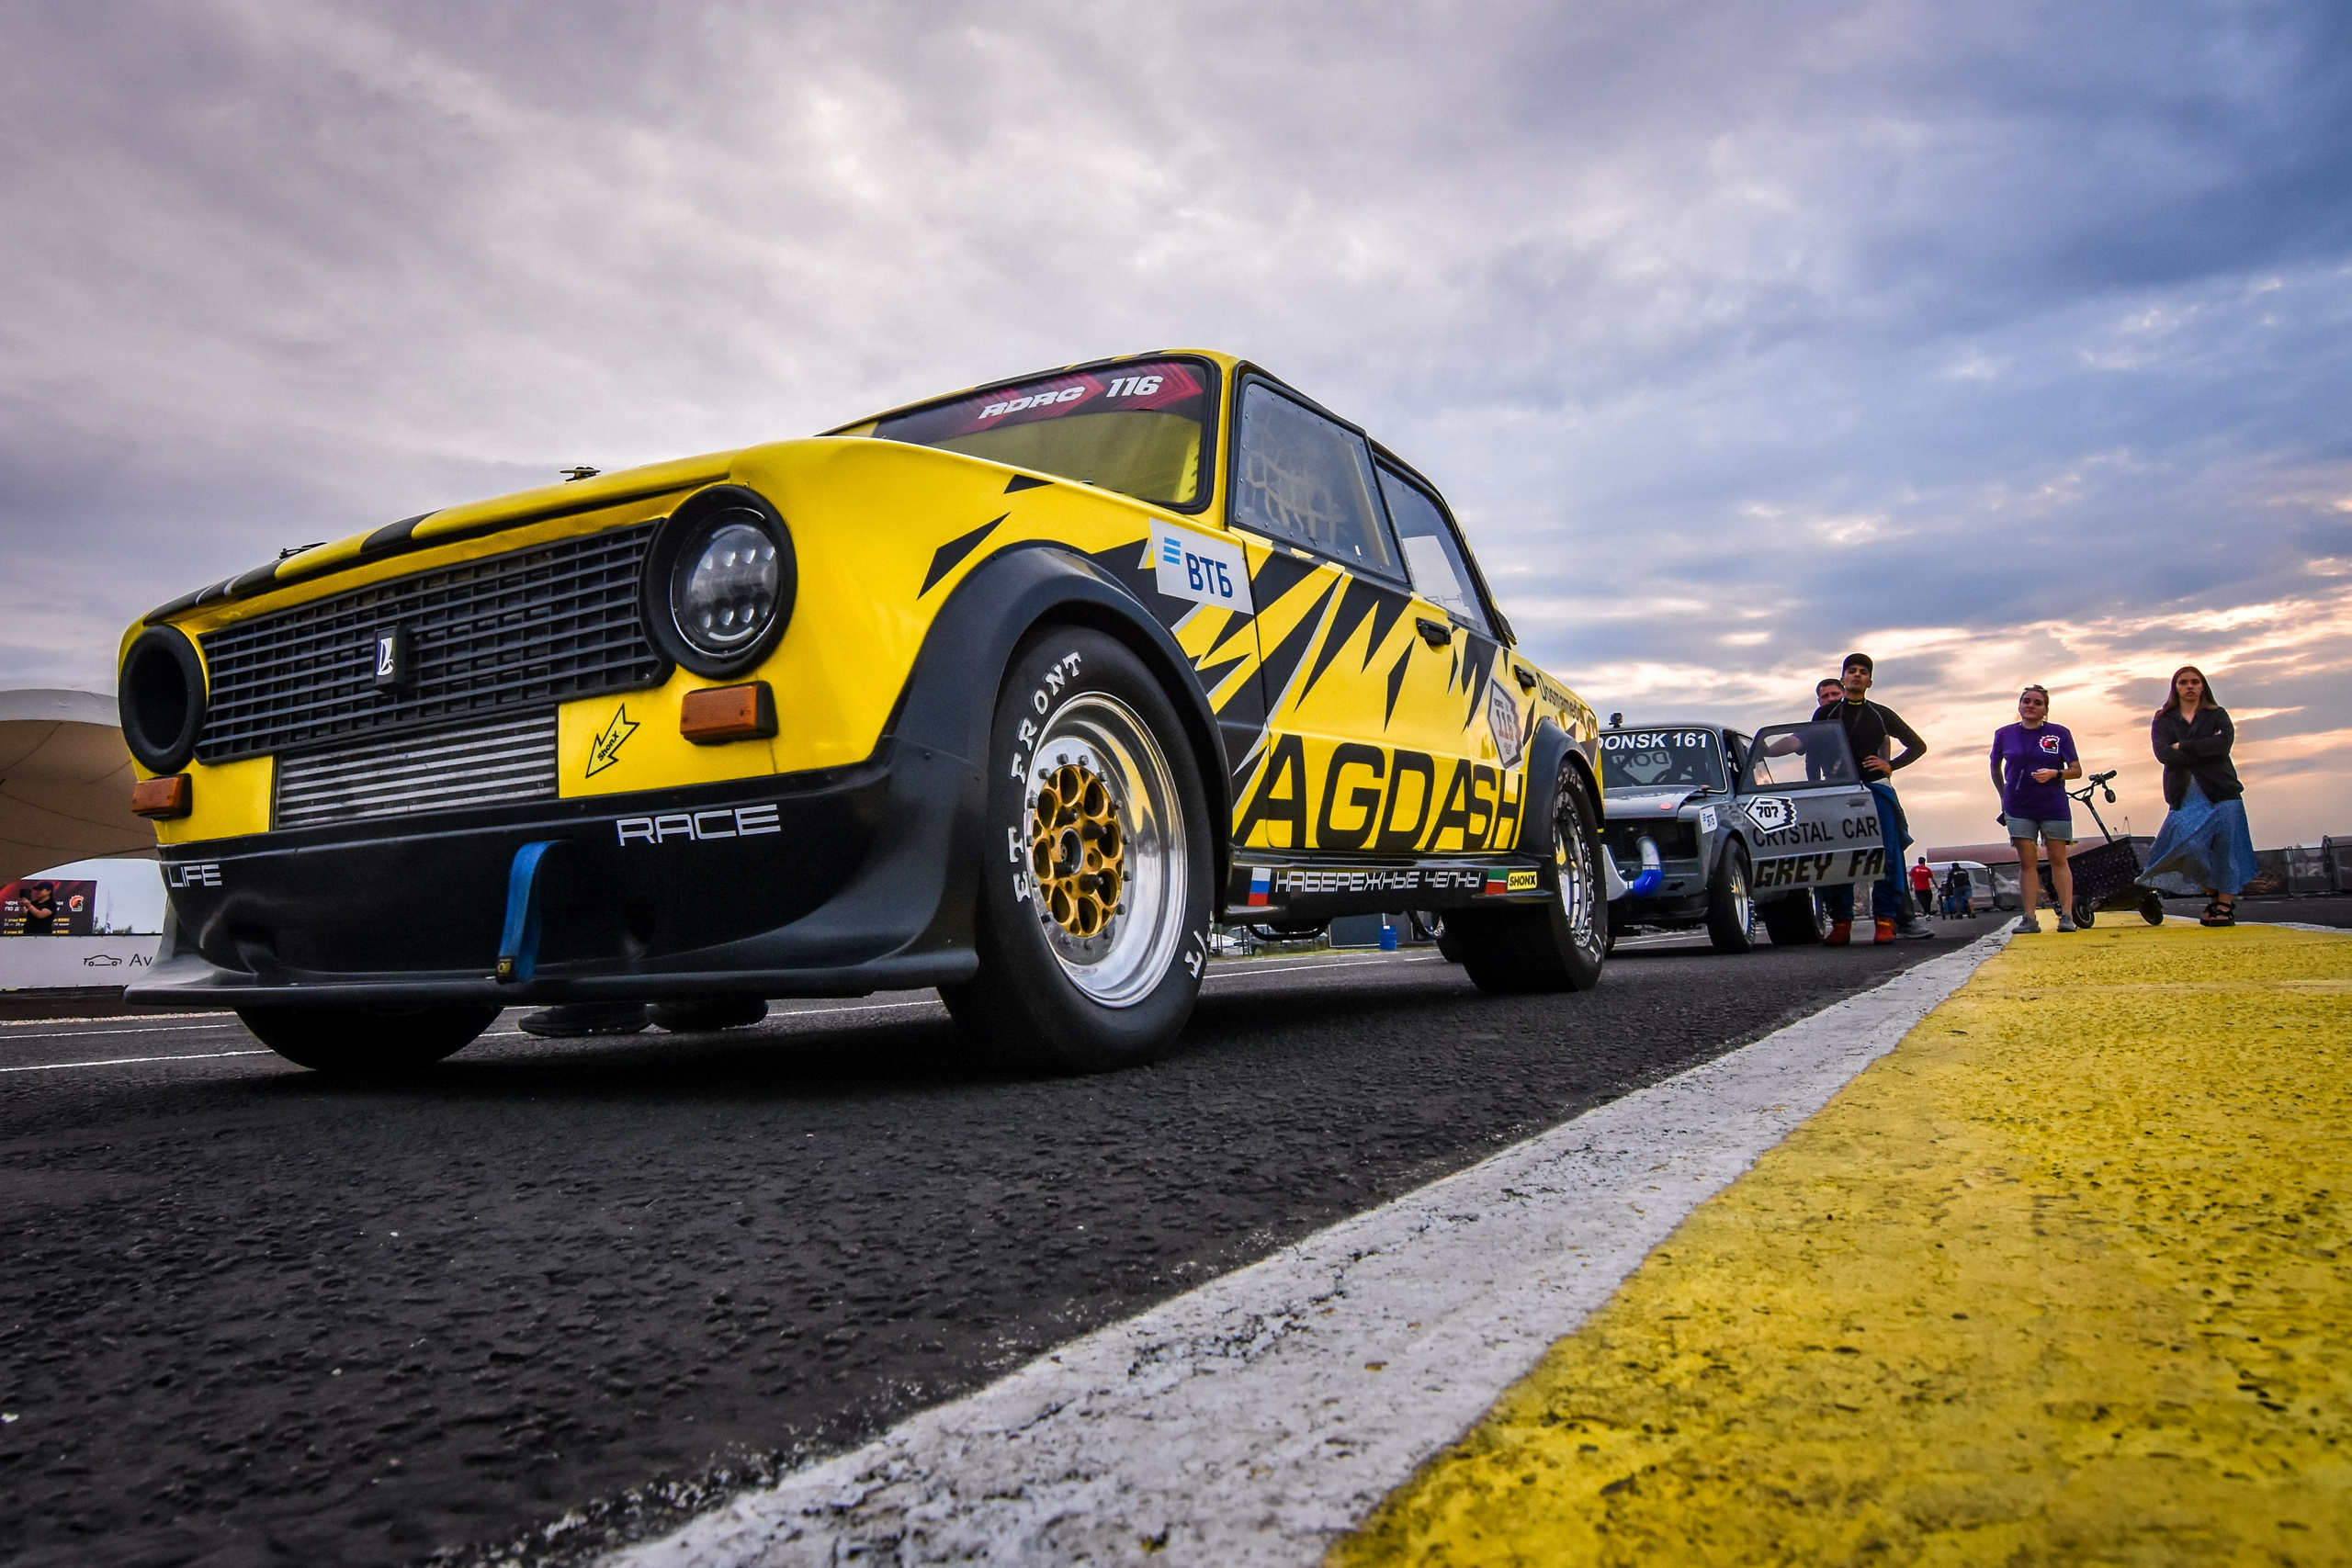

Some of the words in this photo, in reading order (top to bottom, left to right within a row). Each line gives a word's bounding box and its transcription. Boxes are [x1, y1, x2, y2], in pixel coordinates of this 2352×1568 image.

[1106, 376, 1163, 398] 116
[1185, 552, 1233, 598] ВТБ
[1010, 650, 1082, 784] FRONT
[597, 730, 621, 761] ShonX
[1673, 732, 1707, 749] 161
[1231, 732, 1524, 852] AGDASH
[616, 804, 781, 847] RACE
[1756, 806, 1779, 818] 707
[1753, 821, 1834, 848] CRYSTAL
[1842, 817, 1880, 840] CAR
[168, 864, 222, 887] LIFE
[1275, 872, 1420, 893] НАБЕРЕЖНЫЕ
[1425, 871, 1481, 888] ЧЕЛНЫ
[1510, 874, 1536, 887] SHONX
[1754, 852, 1834, 889] GREY
[1848, 848, 1885, 877] FA
[129, 953, 153, 966] Av
